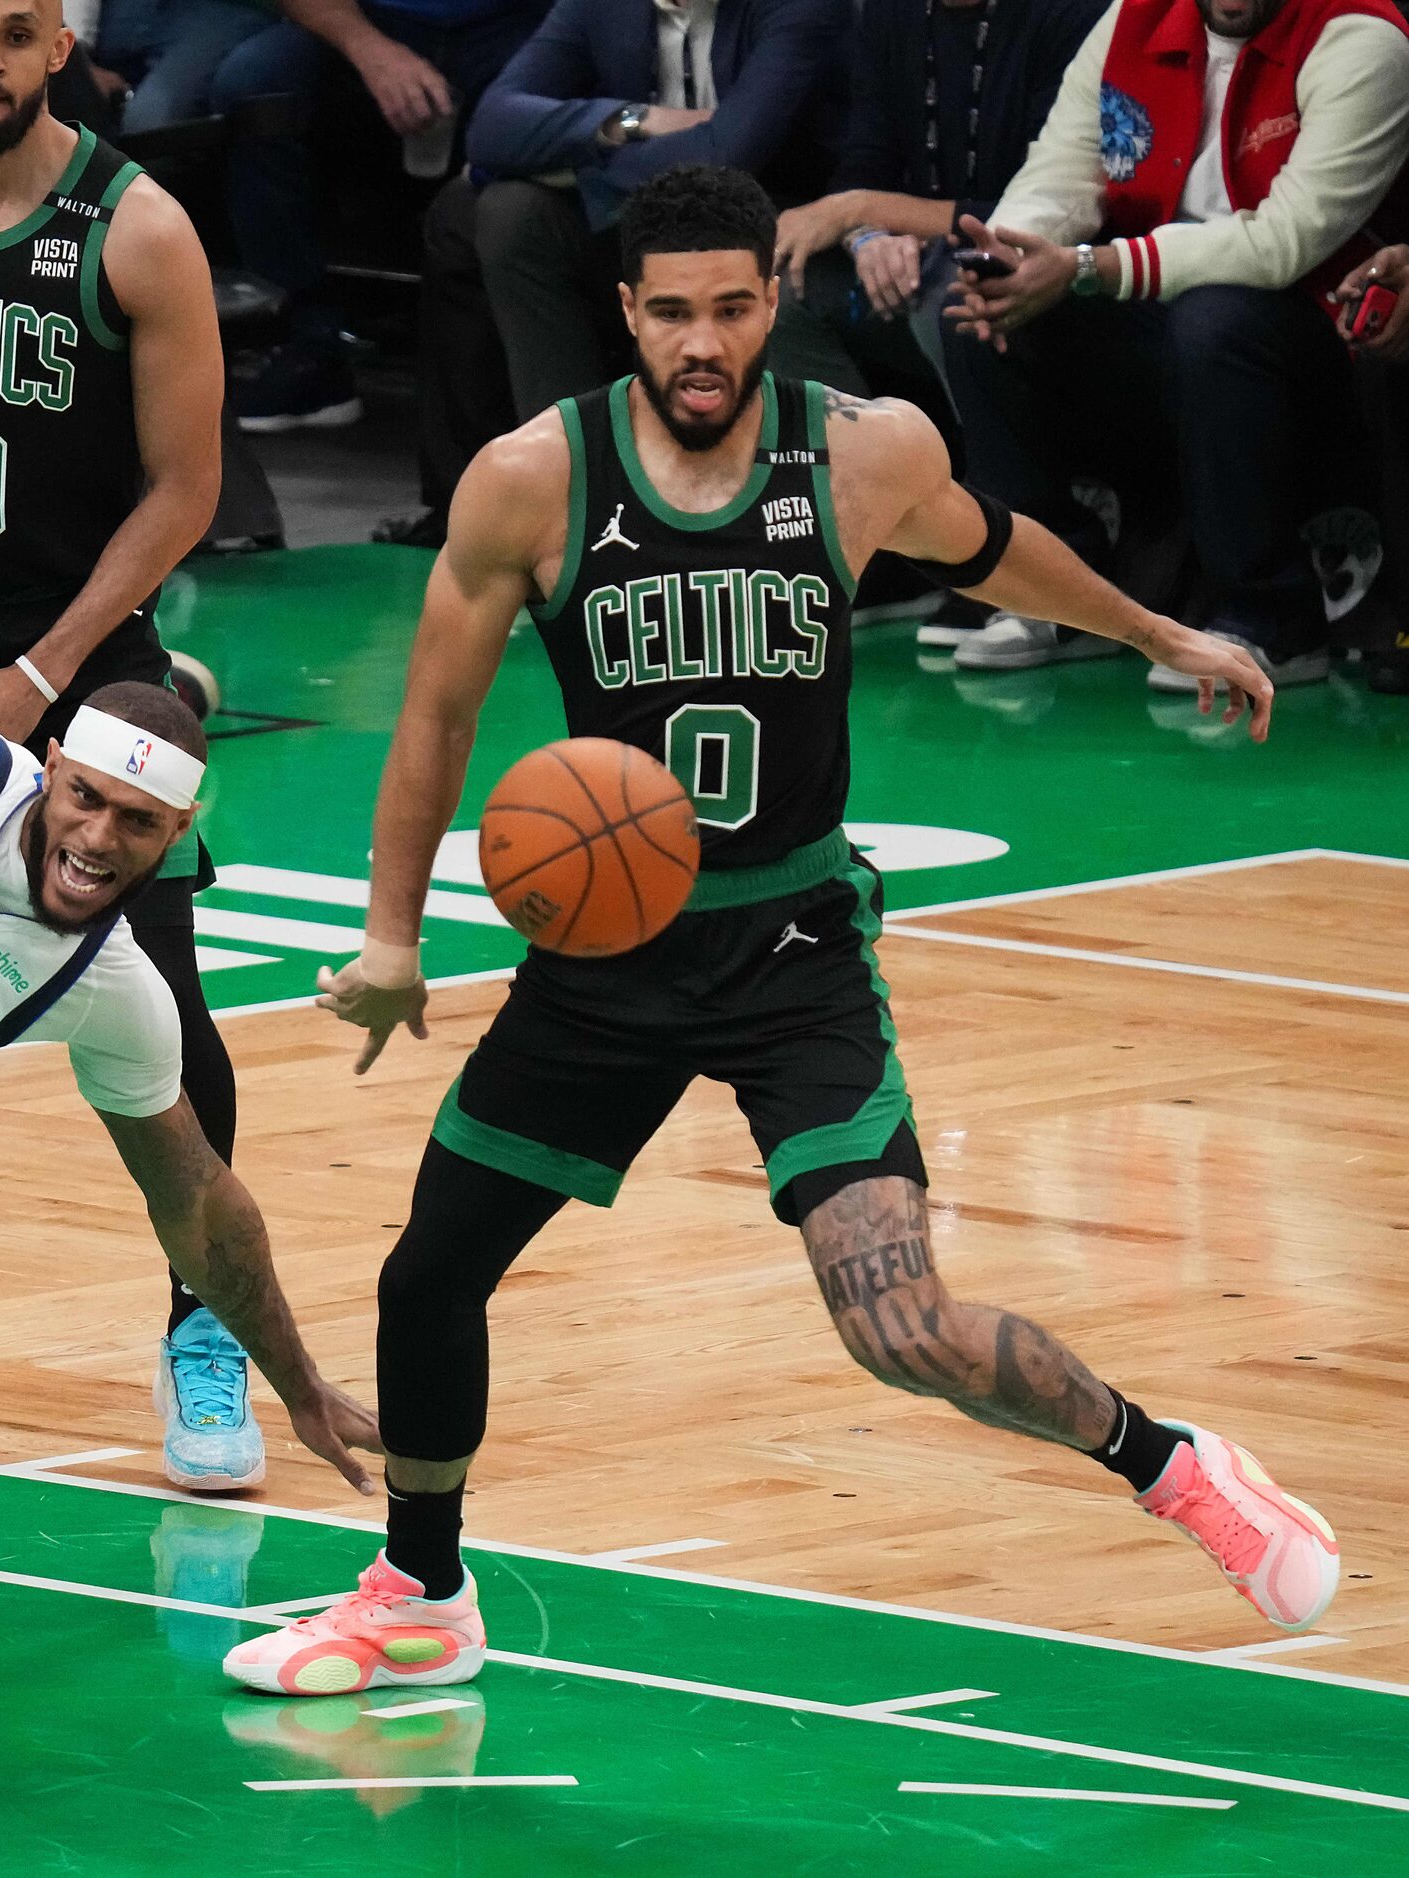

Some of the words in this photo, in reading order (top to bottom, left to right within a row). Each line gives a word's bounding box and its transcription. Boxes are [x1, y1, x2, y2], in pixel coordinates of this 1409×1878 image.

[57, 196, 101, 219] WALTON
[34, 238, 78, 262] VISTA
[31, 260, 78, 279] PRINT
[768, 450, 816, 464] WALTON
[761, 496, 814, 525] VISTA
[765, 518, 815, 542] PRINT
[583, 568, 830, 690] CELTICS
